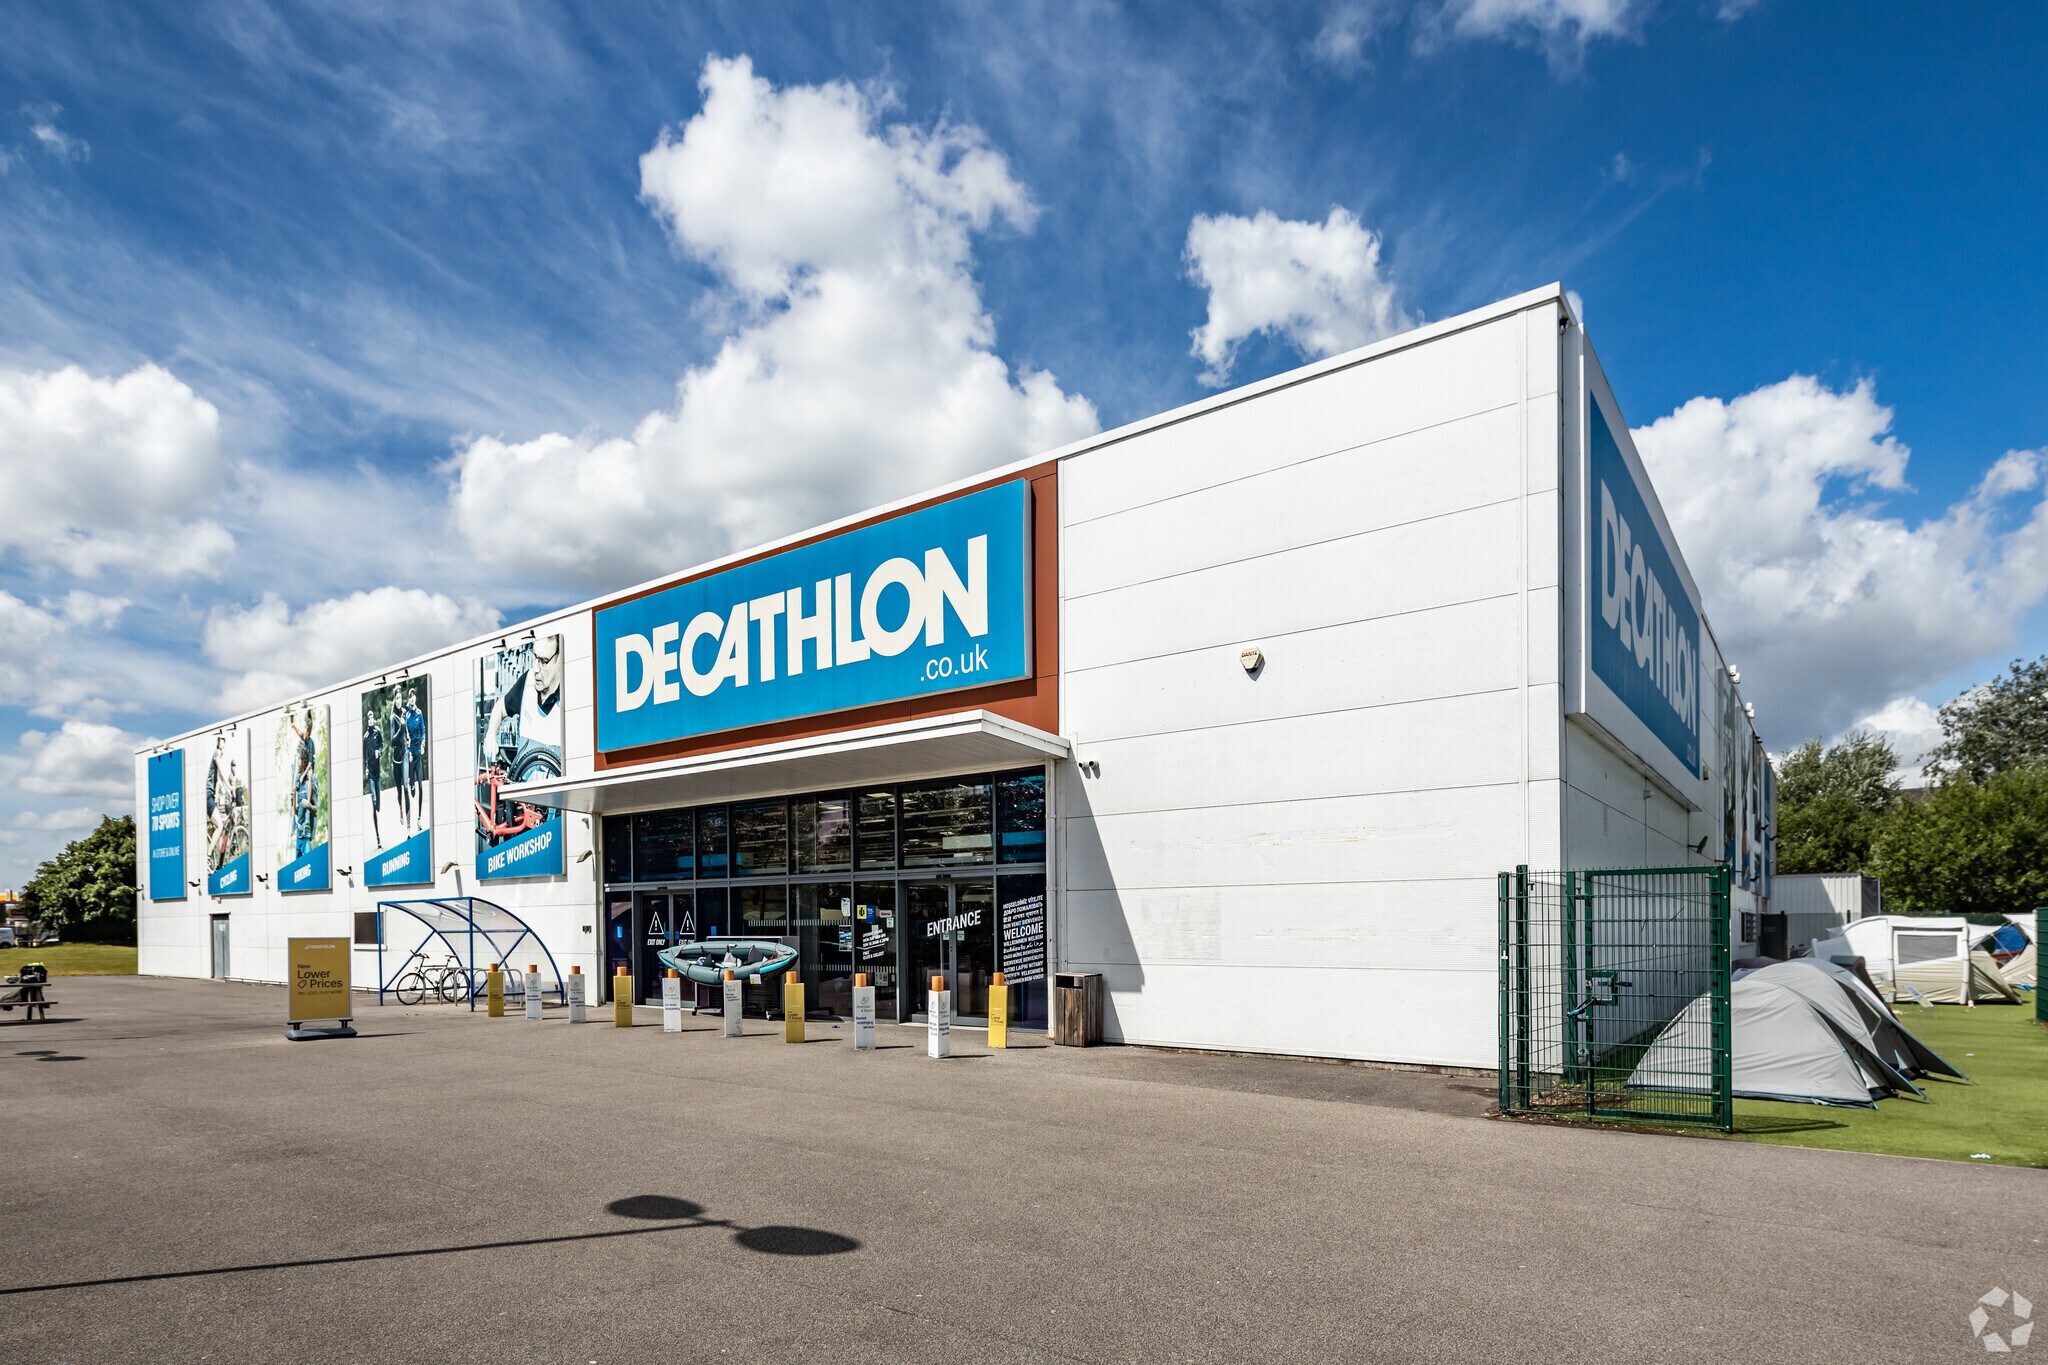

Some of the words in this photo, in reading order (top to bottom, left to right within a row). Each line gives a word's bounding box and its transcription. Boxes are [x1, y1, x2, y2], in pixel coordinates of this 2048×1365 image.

[1601, 478, 1696, 737] DECATHLON
[615, 534, 988, 713] DECATHLON
[920, 643, 988, 681] .co.uk
[152, 796, 165, 813] SHOP
[166, 792, 179, 810] OVER
[159, 811, 180, 830] SPORTS
[488, 851, 505, 873] BIKE
[506, 831, 552, 865] WORKSHOP
[294, 863, 311, 883] HIKING
[382, 851, 410, 877] RUNNING
[927, 909, 981, 937] ENTRANCE
[1003, 922, 1043, 940] WELCOME
[297, 970, 331, 979] Lower
[310, 979, 343, 988] Prices
